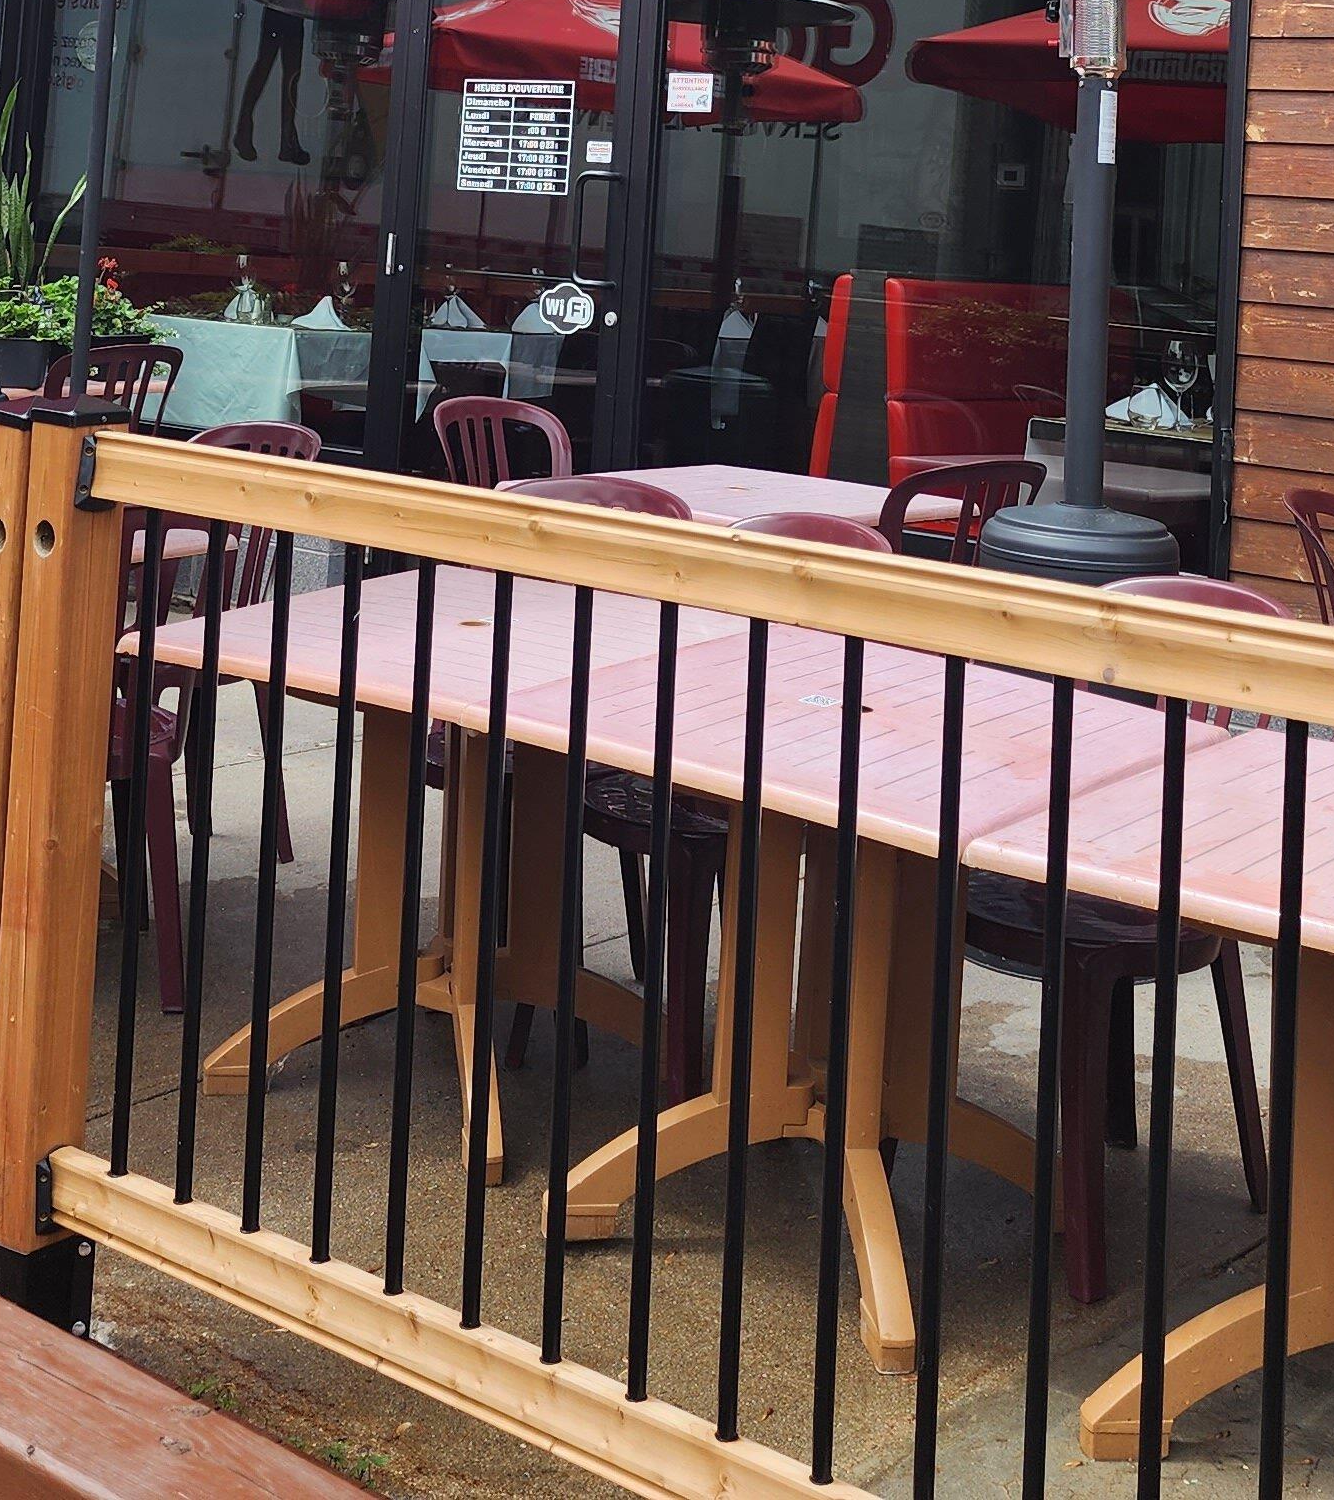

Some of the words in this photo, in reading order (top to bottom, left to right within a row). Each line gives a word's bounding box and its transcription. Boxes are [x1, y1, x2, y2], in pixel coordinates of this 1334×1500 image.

[473, 84, 507, 93] HEURES
[466, 97, 510, 107] Dimanche
[465, 111, 490, 120] Lundi
[464, 125, 489, 134] Mardi
[463, 138, 502, 148] Mercredi
[462, 153, 487, 161] Jeudi
[461, 165, 501, 175] Vendredi
[460, 179, 494, 188] Samedi
